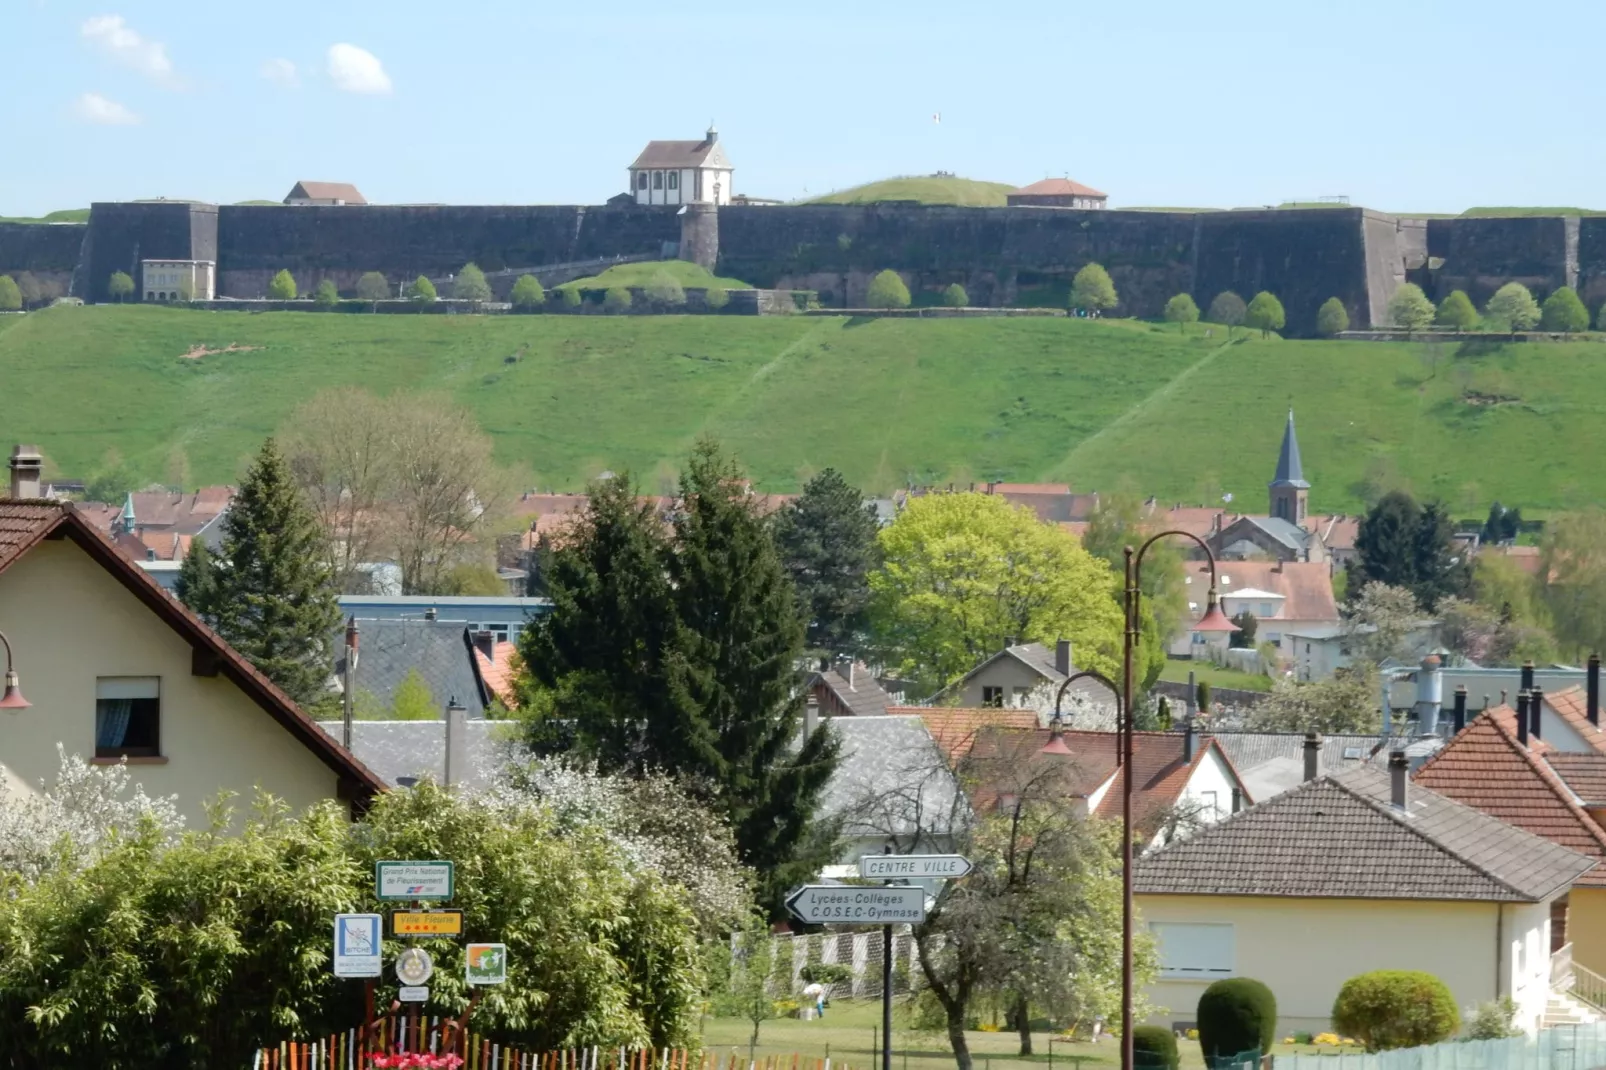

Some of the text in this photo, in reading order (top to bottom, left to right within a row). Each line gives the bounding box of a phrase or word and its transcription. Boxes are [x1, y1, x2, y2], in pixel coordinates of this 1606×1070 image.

[383, 867, 447, 875] Grand Prix National
[870, 861, 956, 873] CENTRE VILLE
[400, 915, 455, 924] Ville Fleurie
